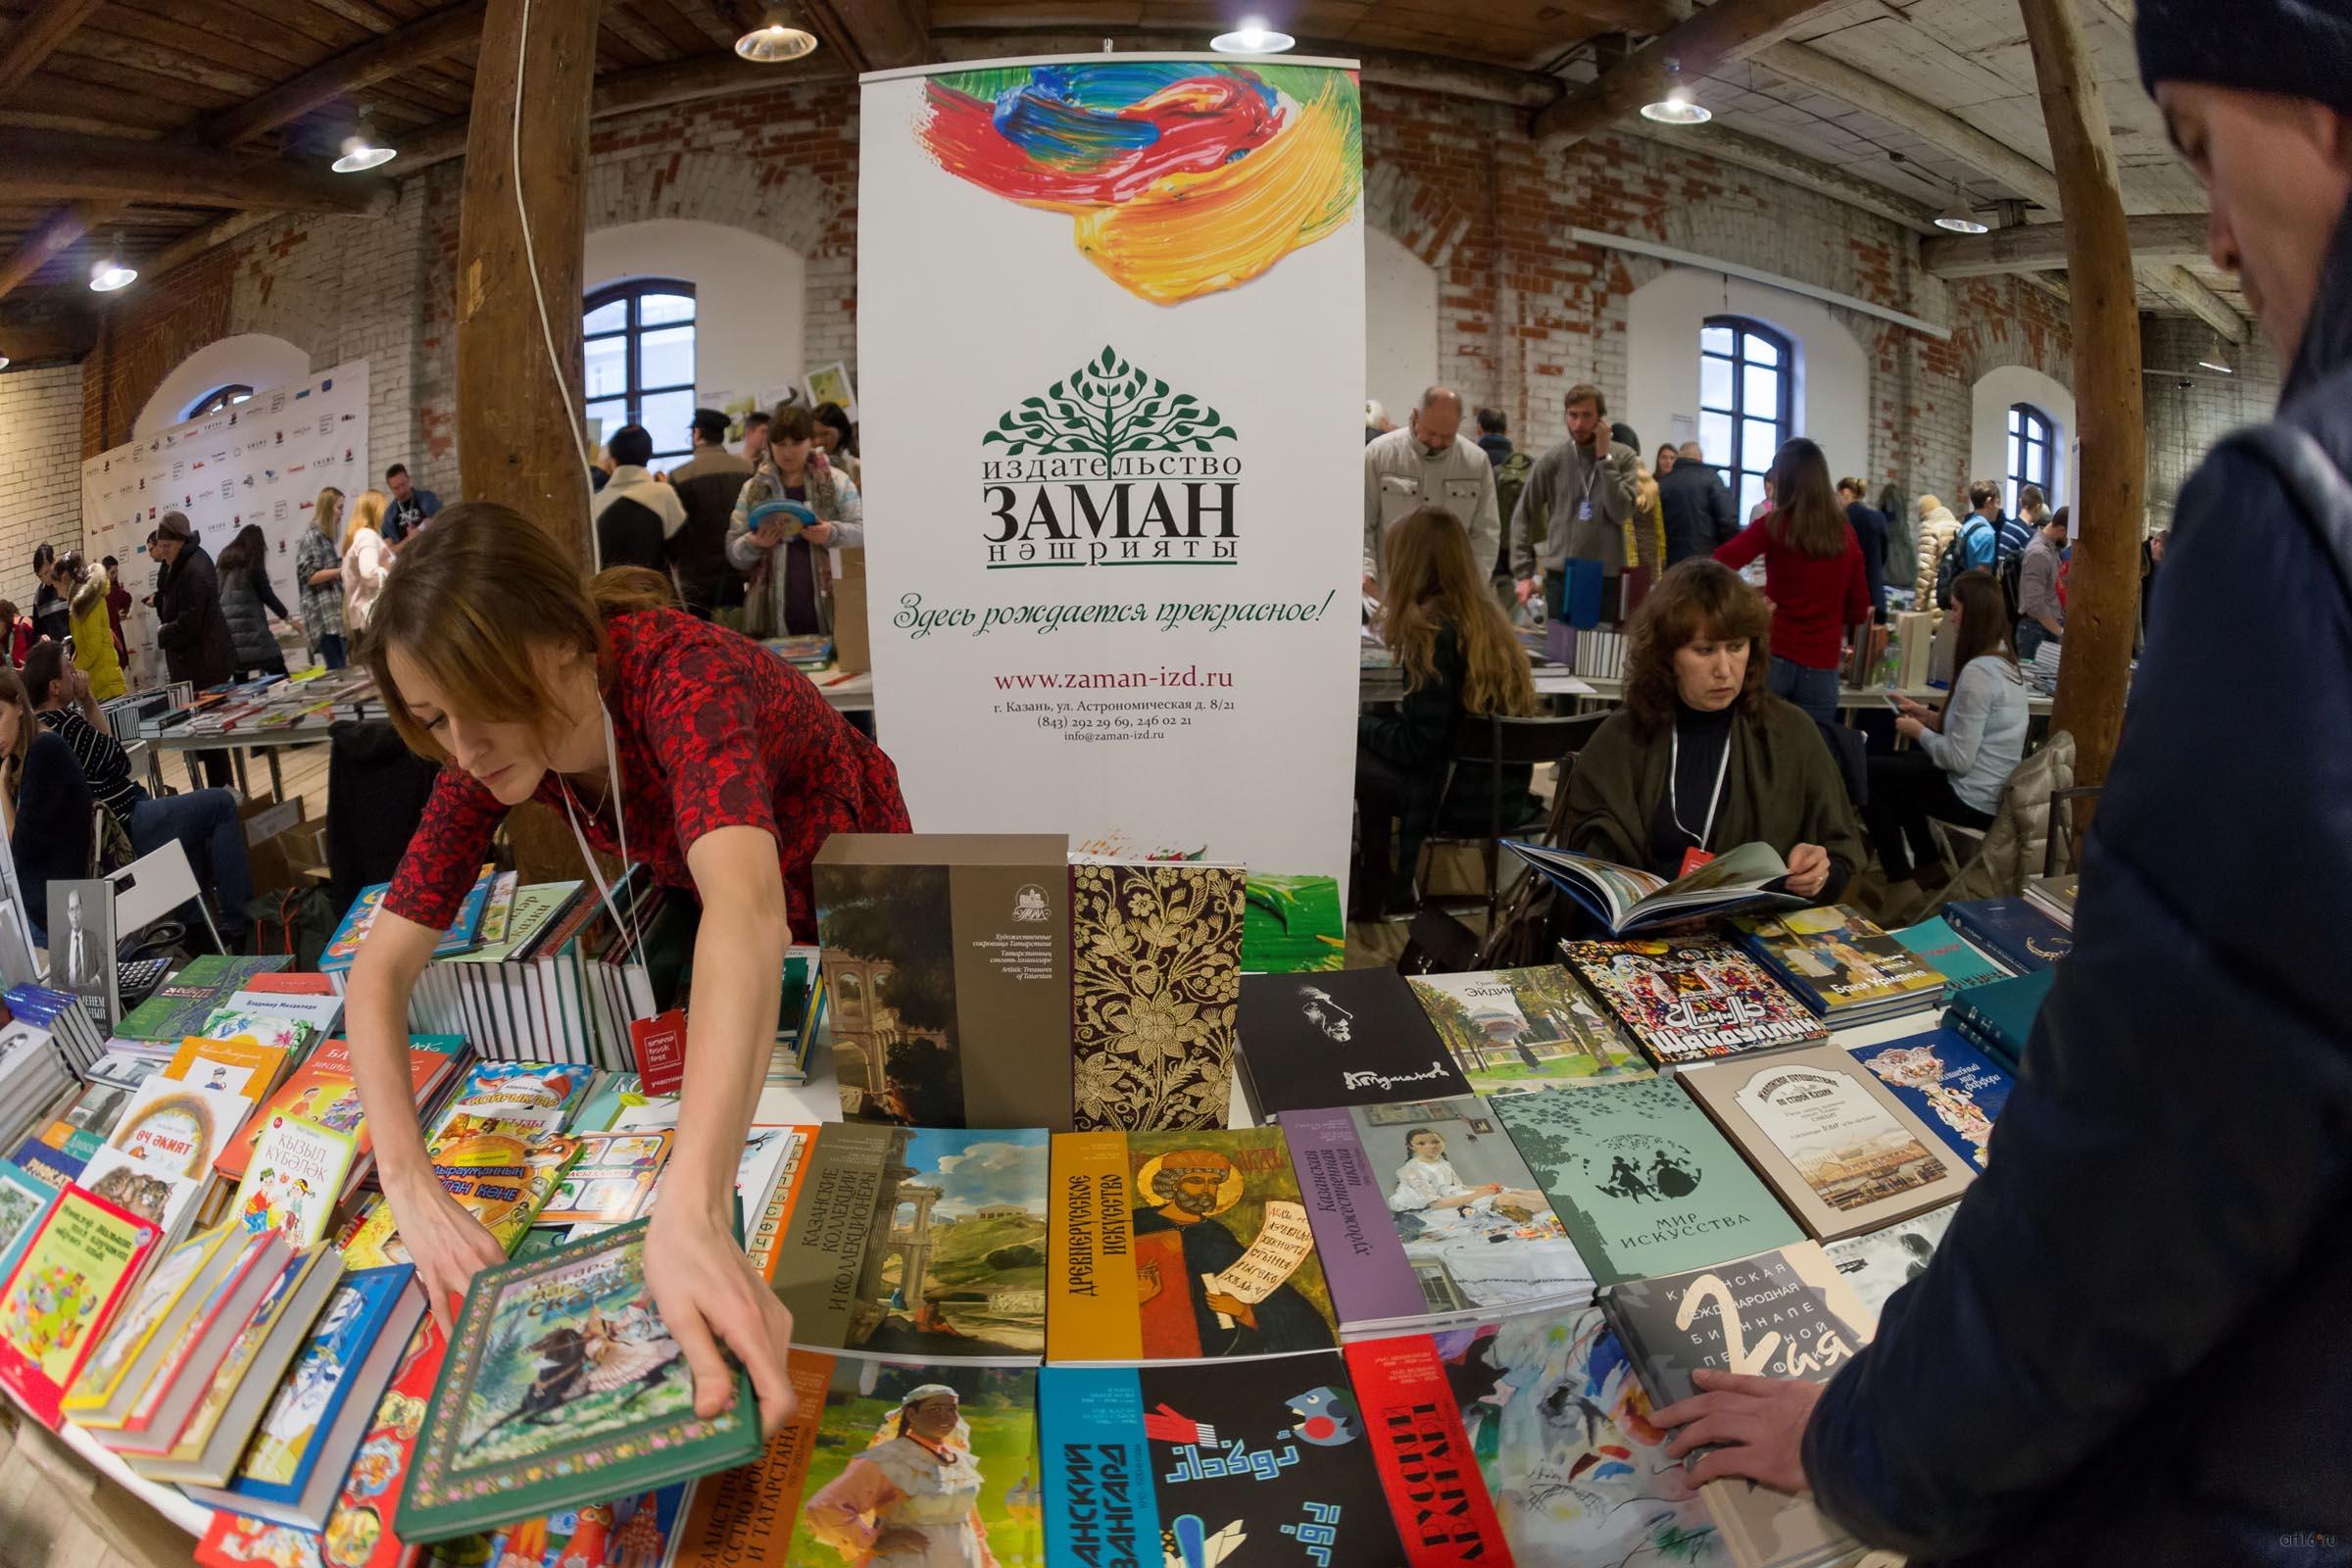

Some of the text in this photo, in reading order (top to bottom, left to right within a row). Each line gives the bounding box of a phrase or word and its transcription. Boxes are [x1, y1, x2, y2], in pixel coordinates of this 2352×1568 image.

[982, 455, 1243, 482] издательство
[983, 482, 1240, 543] ЗАМАН
[987, 540, 1238, 566] нәшрияты
[893, 588, 1337, 640] Здесь рождается прекрасное!
[994, 664, 1234, 691] www.zaman-izd.ru
[994, 699, 1235, 714] г. Казань, ул. Астрономическая д. 8/21
[1037, 715, 1192, 730] (843) 292 29 69, 246 02 21
[1063, 729, 1165, 744] info@zaman-izd.ru
[649, 1045, 670, 1055] book
[152, 1135, 193, 1155] ӘКИЯТ
[266, 1144, 329, 1183] КҮБӘЛӘК
[278, 1133, 327, 1163] КЫЗЫЛ
[1312, 1149, 1336, 1214] Казанская
[1347, 1149, 1364, 1189] школа
[474, 1184, 520, 1203] КӨНЕ
[802, 1167, 840, 1248] КАЗАНСКИЕ
[821, 1169, 859, 1254] КОЛЛЕКЦИИ
[1331, 1149, 1372, 1256] художественная
[836, 1171, 877, 1293] КОЛЛЕКЦИОНЕРЫ
[1102, 1173, 1127, 1256] ИСКУССТВО
[1620, 1213, 1753, 1250] ИСКУССТВА
[1654, 1211, 1699, 1231] МИР
[1665, 1262, 1788, 1302] КАНСКАЯ
[829, 1292, 847, 1312] И
[757, 1424, 800, 1536] ТАТАРСТАНА
